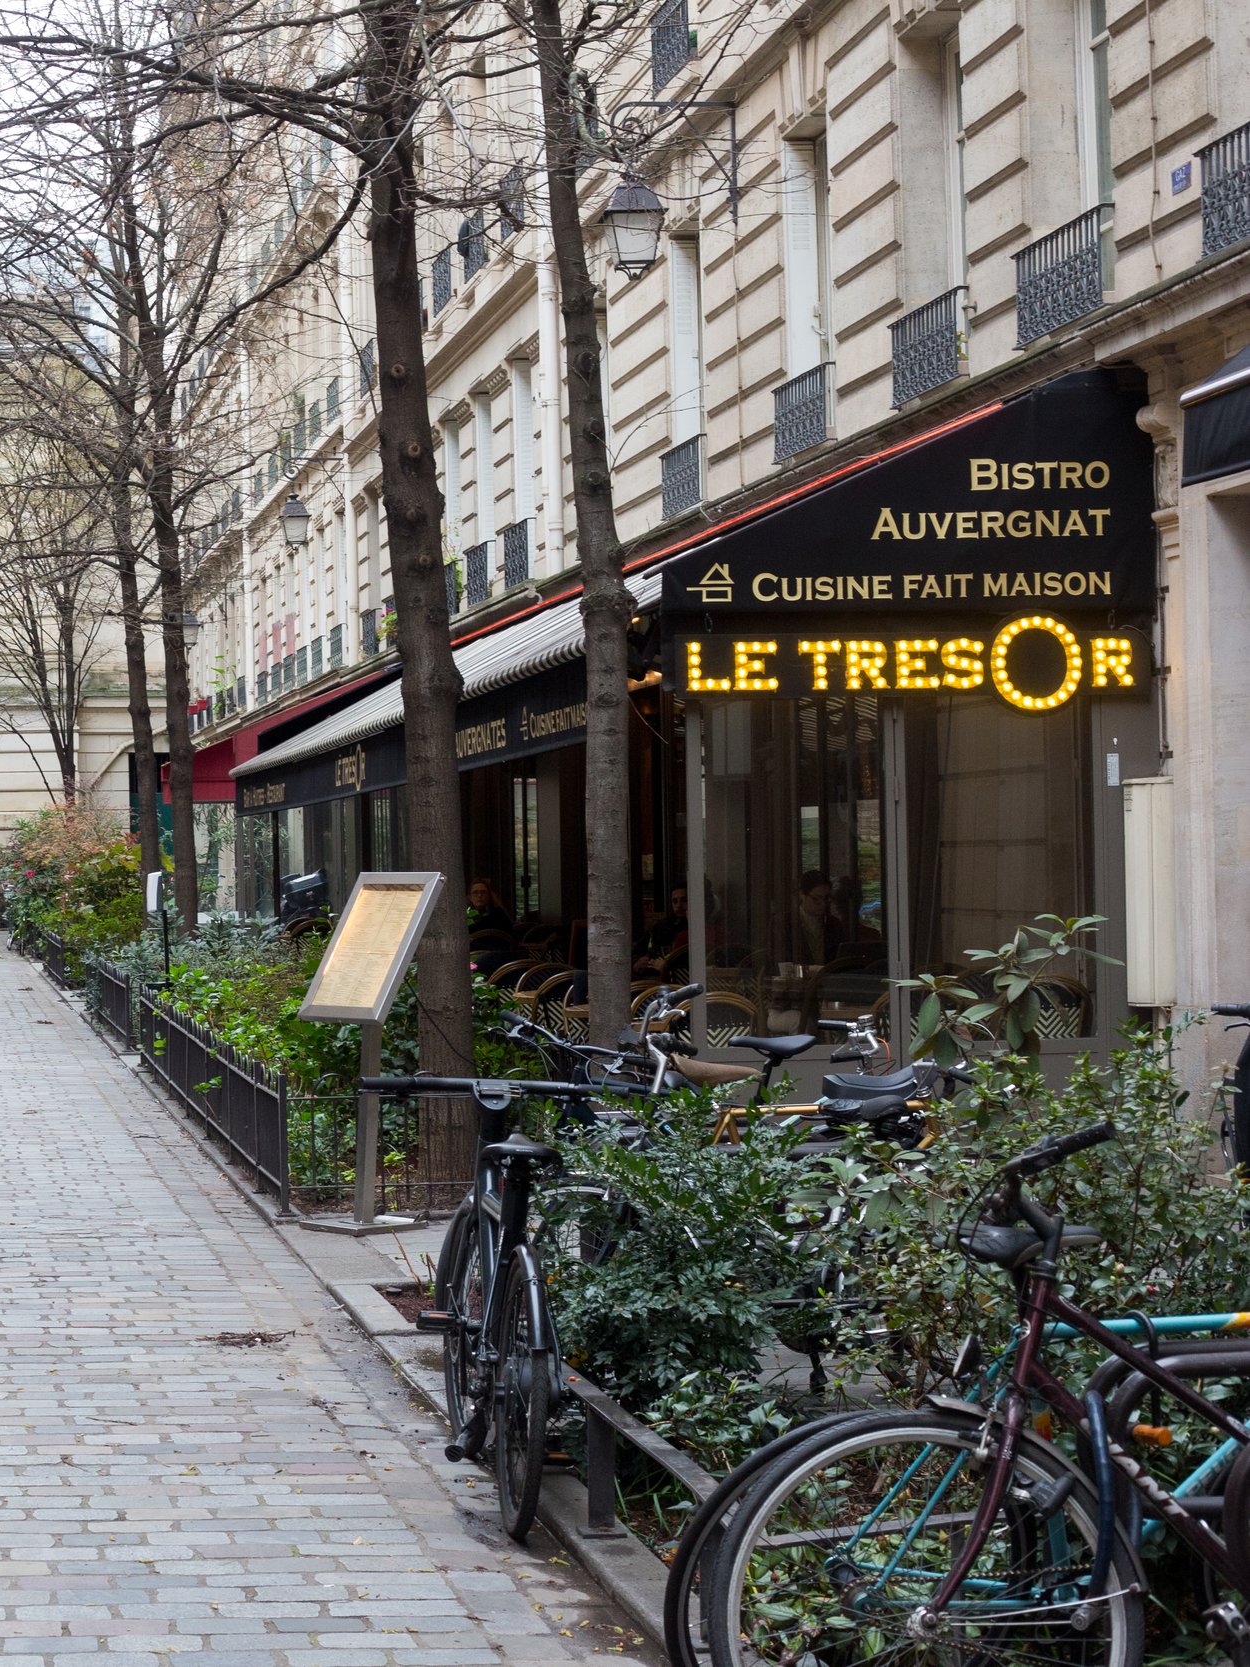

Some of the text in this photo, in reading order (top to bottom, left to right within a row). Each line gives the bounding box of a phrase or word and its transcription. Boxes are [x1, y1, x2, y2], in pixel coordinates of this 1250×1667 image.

[969, 458, 1111, 491] BISTRO
[870, 507, 1111, 540] AUVERGNAT
[751, 571, 1112, 602] CUISINE FAIT MAISON
[686, 615, 1136, 711] LE TRESOR
[570, 702, 588, 728] MAIS
